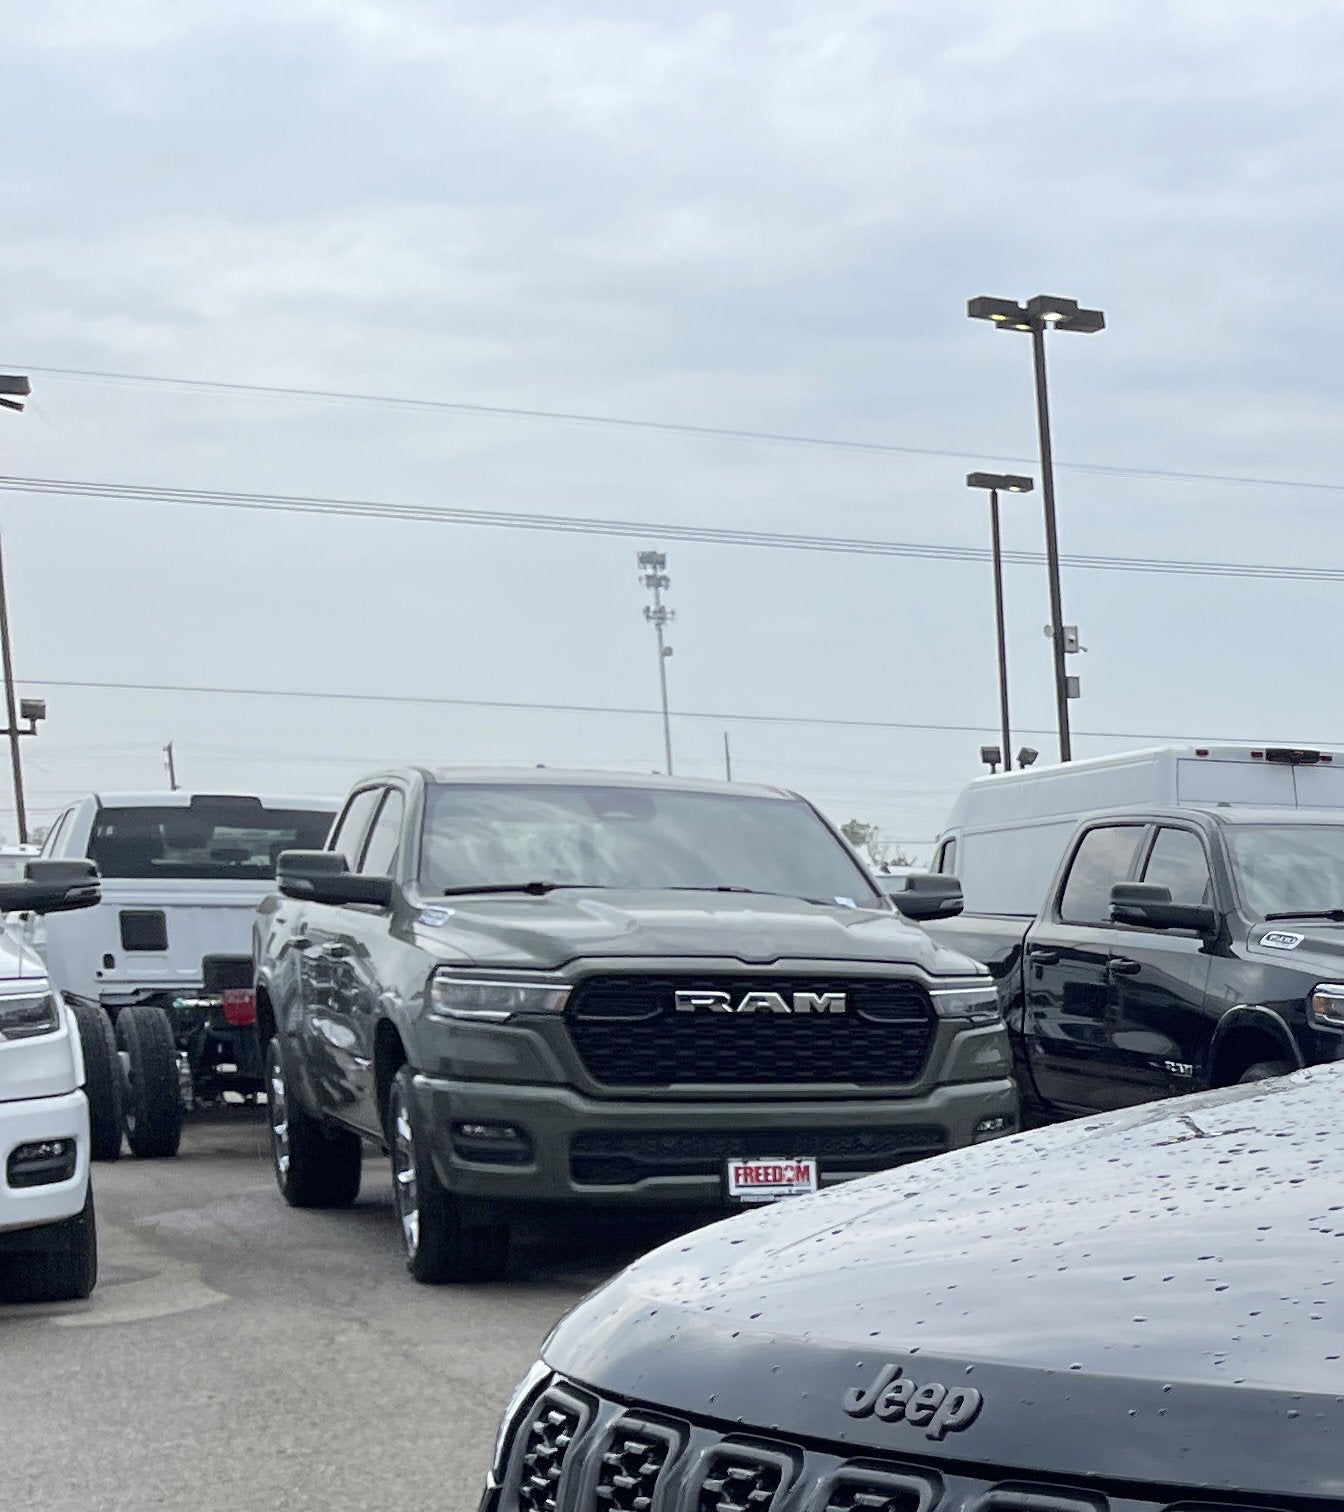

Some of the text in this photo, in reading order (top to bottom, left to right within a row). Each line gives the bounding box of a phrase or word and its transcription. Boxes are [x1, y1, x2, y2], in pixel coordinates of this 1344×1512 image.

[675, 990, 847, 1012] RAM
[734, 1165, 810, 1184] FREEDOM
[842, 1363, 984, 1441] Jeep
